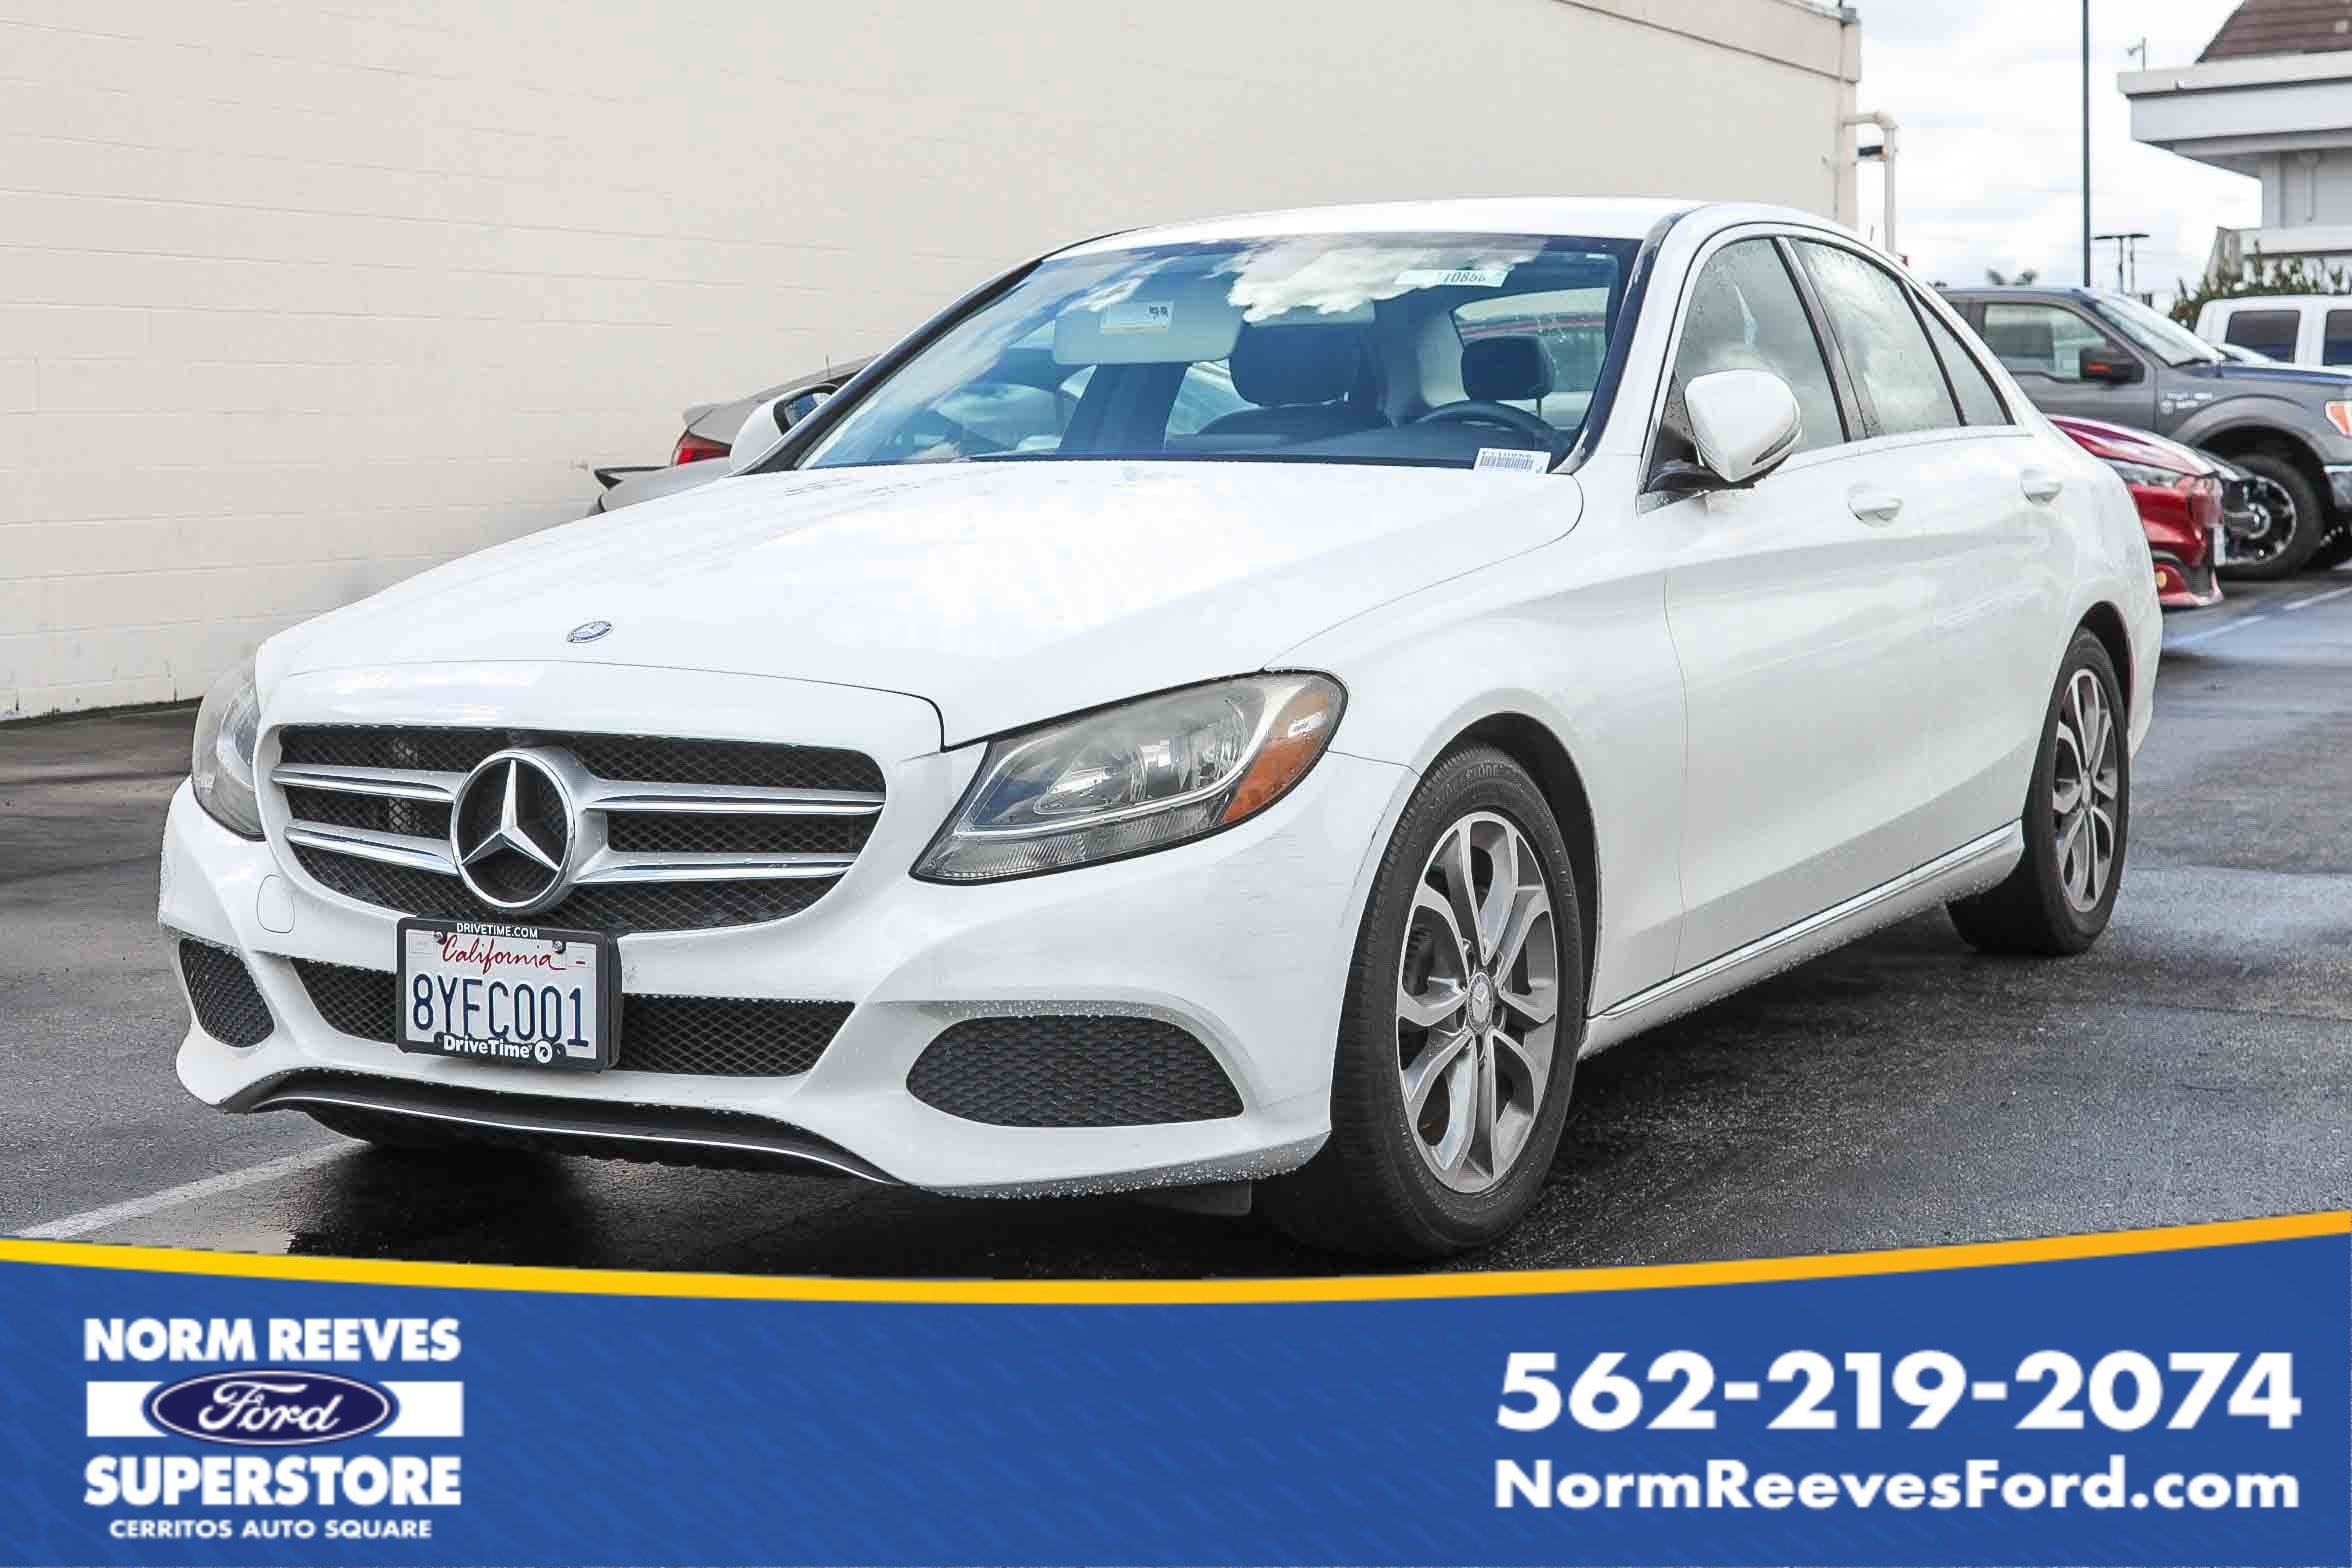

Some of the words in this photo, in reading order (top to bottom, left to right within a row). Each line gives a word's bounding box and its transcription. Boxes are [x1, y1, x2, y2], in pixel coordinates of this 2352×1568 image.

[456, 922, 538, 938] DRIVETIME.COM
[441, 934, 566, 975] California
[412, 973, 589, 1047] 8YFC001
[443, 1035, 530, 1057] DriveTime
